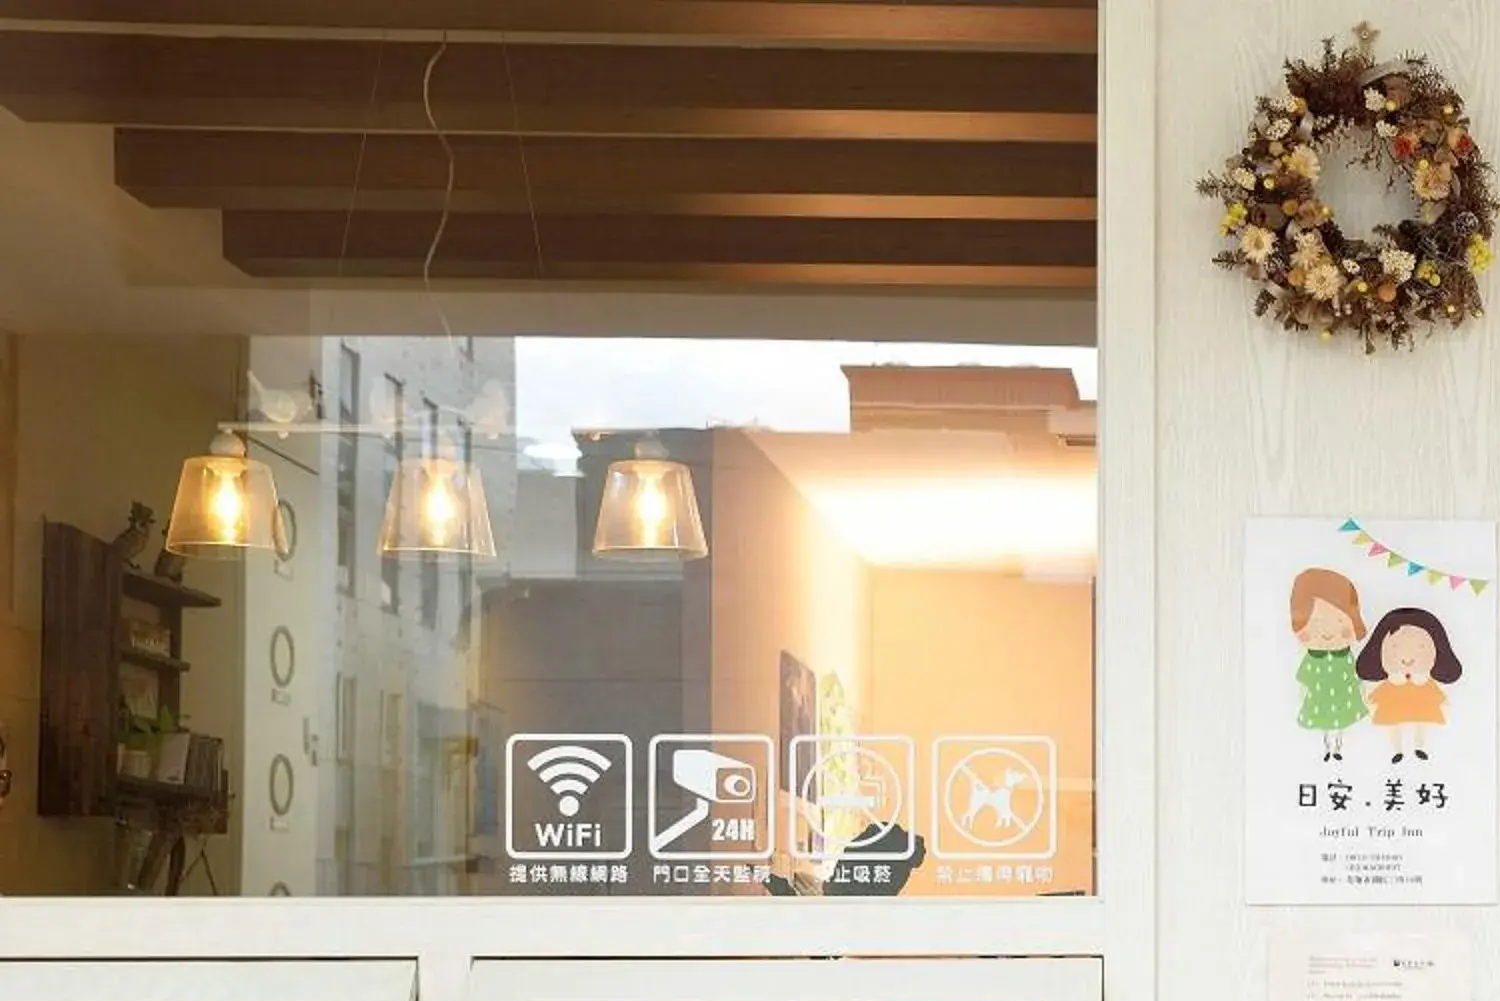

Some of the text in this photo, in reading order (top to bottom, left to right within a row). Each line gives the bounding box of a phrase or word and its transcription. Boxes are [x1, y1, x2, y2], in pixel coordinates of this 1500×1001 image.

[535, 823, 602, 848] WiFi
[711, 818, 756, 842] 24H
[1319, 825, 1423, 840] Joyful Trip Inn
[508, 864, 629, 884] 提供無線網路
[813, 864, 892, 884] 止吸菸
